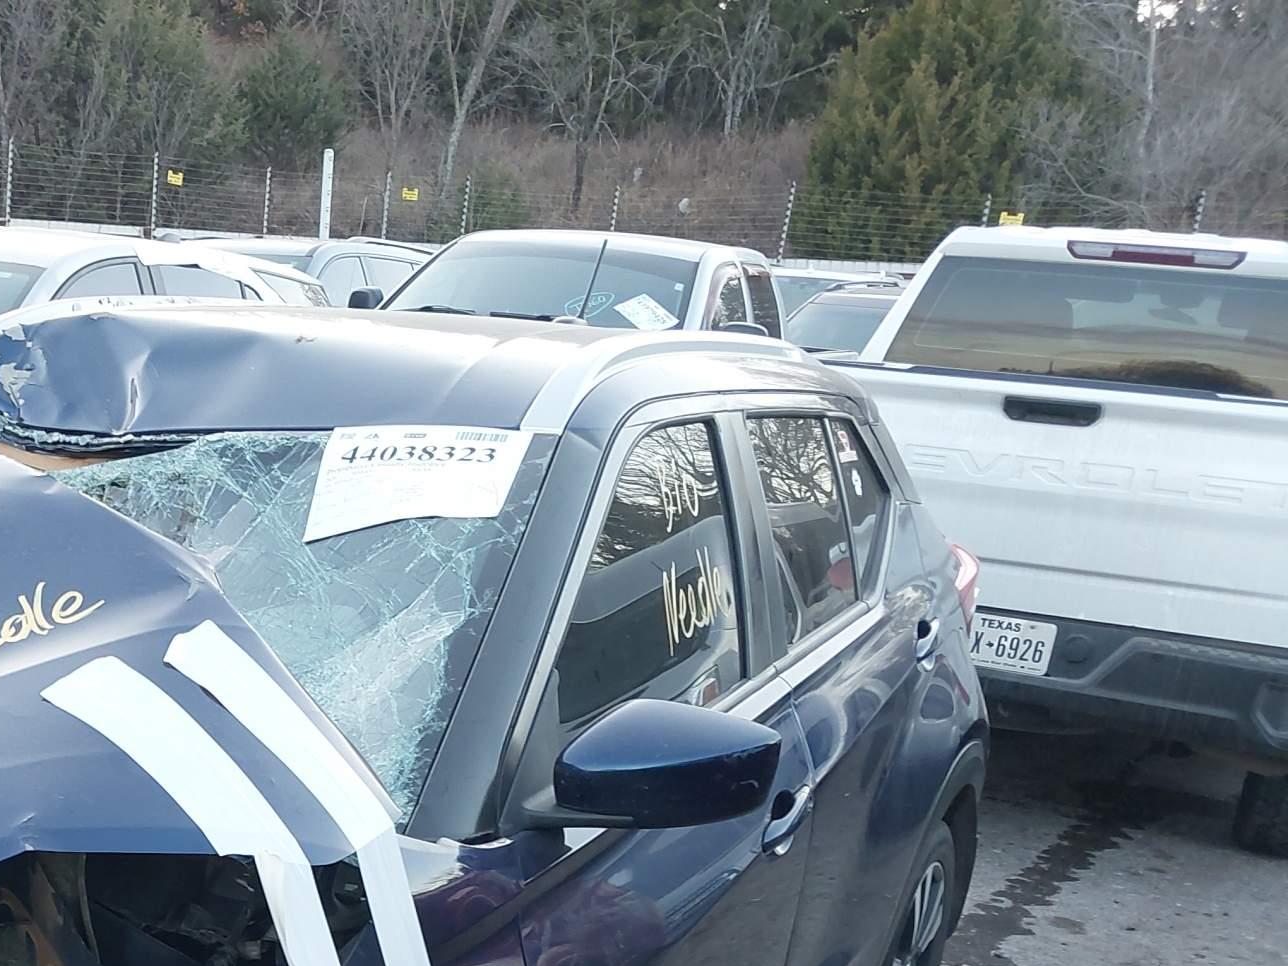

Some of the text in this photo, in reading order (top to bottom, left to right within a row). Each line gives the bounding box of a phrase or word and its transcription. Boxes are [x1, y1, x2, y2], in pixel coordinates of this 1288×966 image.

[341, 445, 497, 464] 44038323
[662, 546, 730, 657] Needle
[981, 617, 1022, 633] TEXAS
